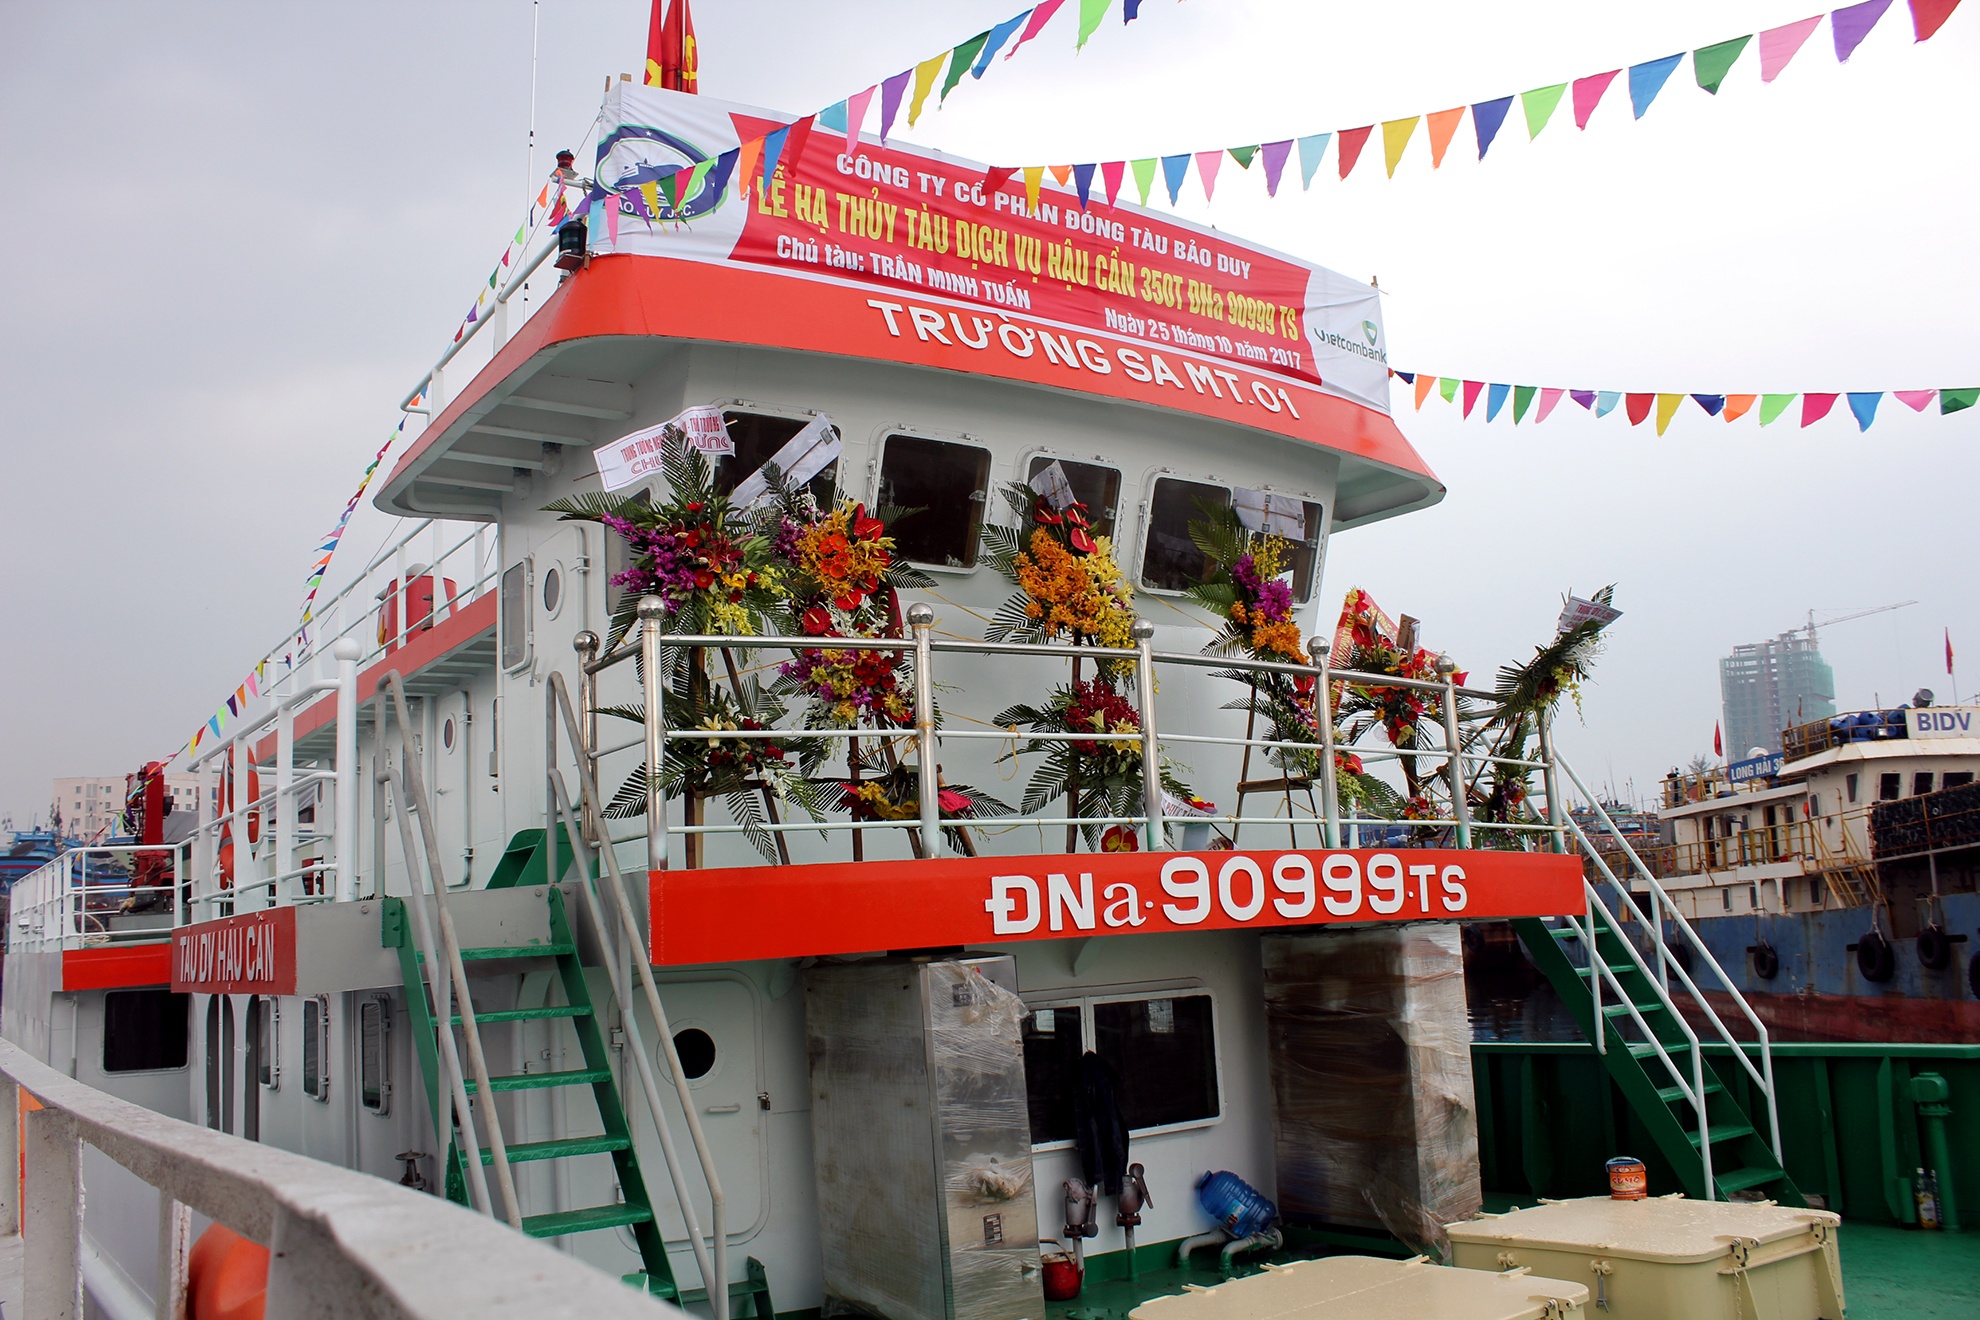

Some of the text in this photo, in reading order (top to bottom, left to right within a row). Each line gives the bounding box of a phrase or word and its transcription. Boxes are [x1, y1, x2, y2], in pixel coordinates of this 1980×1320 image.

[835, 152, 910, 190] CÔNG
[917, 171, 947, 197] TY
[1065, 210, 1125, 243] ĐÓNG
[1130, 226, 1169, 255] TÀU
[1173, 238, 1213, 268] BẢO
[1217, 252, 1252, 280] DUY
[756, 164, 1299, 342] LỄ HẠ THỦY TÀU DỊCH VỤ HẬU CẦN 350T ĐNa 90999 TS
[776, 234, 1032, 310] Chủ tàu: TRẦN MINH TUẤN
[866, 299, 1301, 420] TRƯỜNG SA MT.01
[1104, 307, 1301, 371] Ngày 25 tháng 10 năm 2017
[1313, 327, 1388, 365] Vietcombank
[1916, 711, 1972, 732] BIDV
[1730, 764, 1754, 781] LONG
